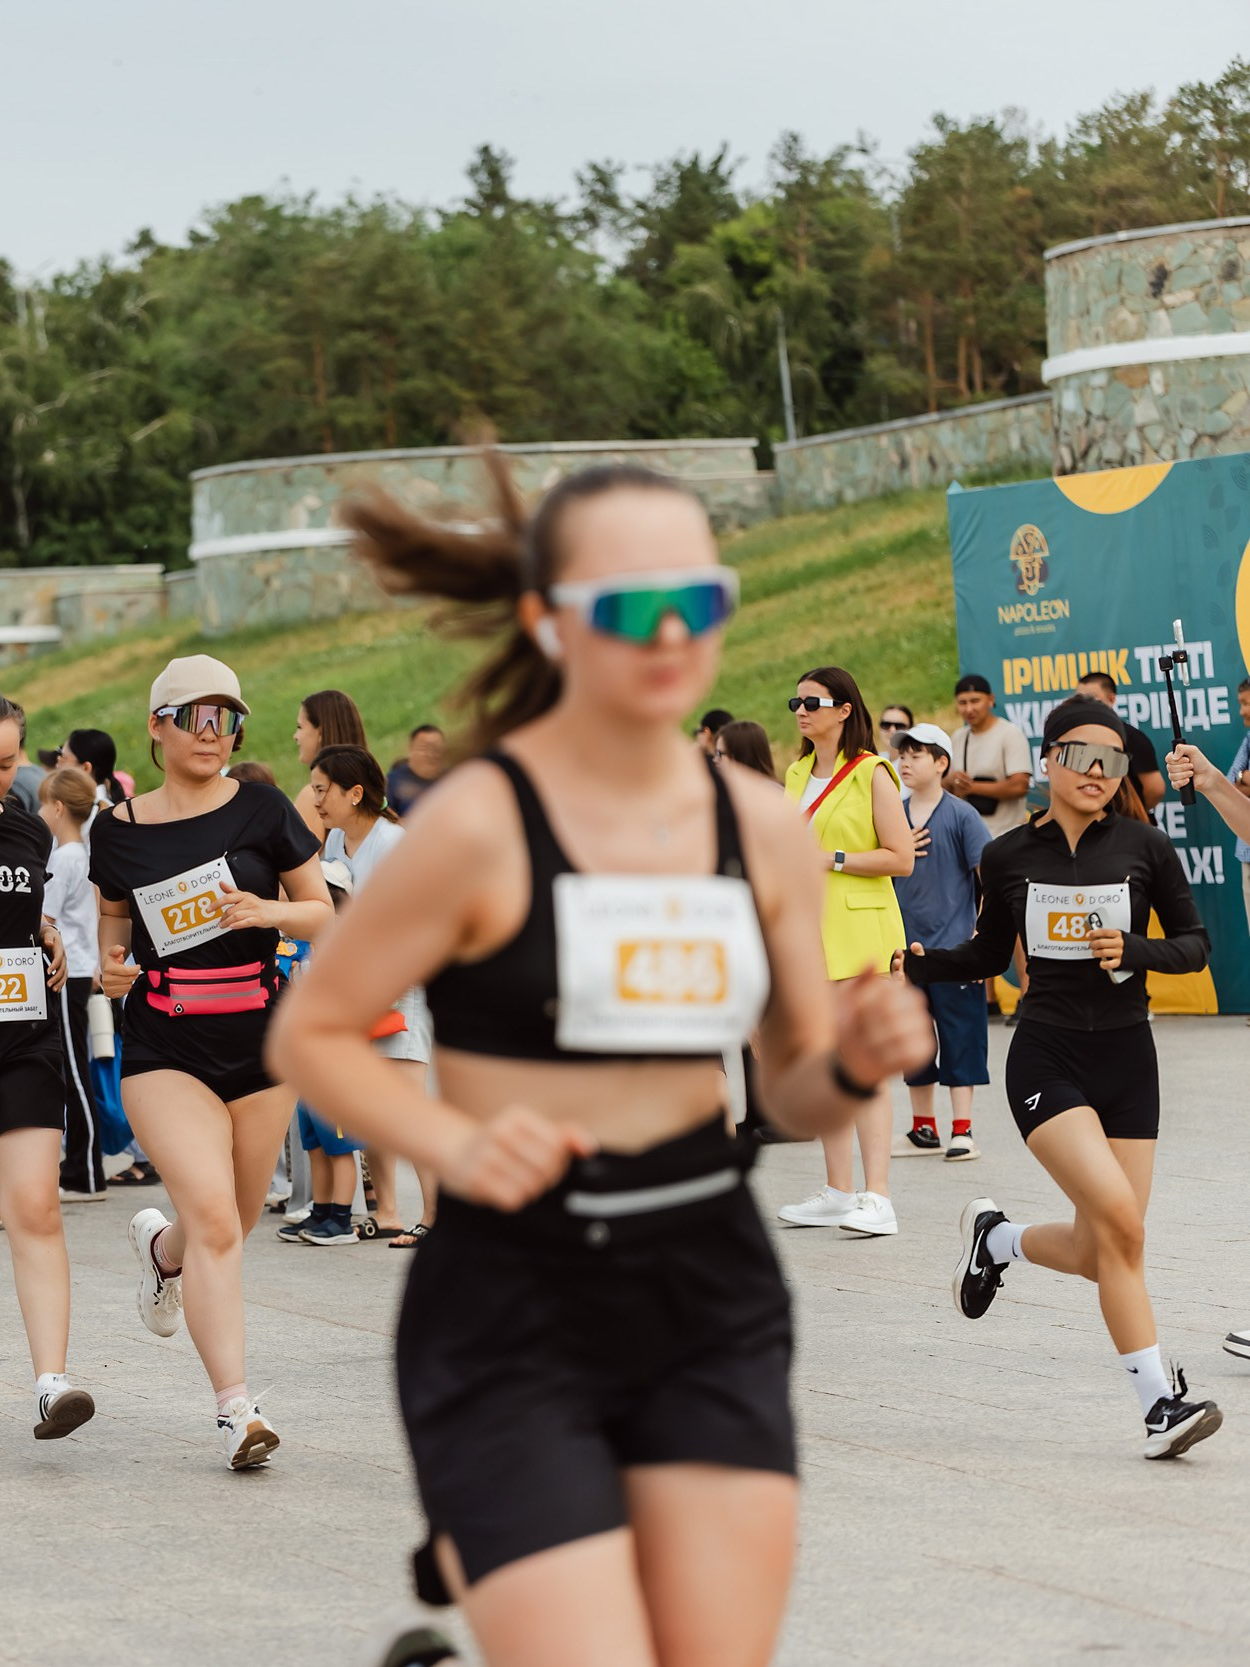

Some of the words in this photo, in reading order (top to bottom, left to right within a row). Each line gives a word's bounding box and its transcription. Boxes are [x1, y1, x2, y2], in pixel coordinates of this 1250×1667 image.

[997, 598, 1070, 624] NAPOLEON
[143, 889, 176, 905] LEONE
[190, 870, 221, 889] D'ORO
[1035, 894, 1070, 905] LEONE
[1089, 894, 1121, 905] D'ORO
[168, 896, 216, 931] 278
[1052, 915, 1086, 939] 48
[7, 957, 35, 967] D'ORO
